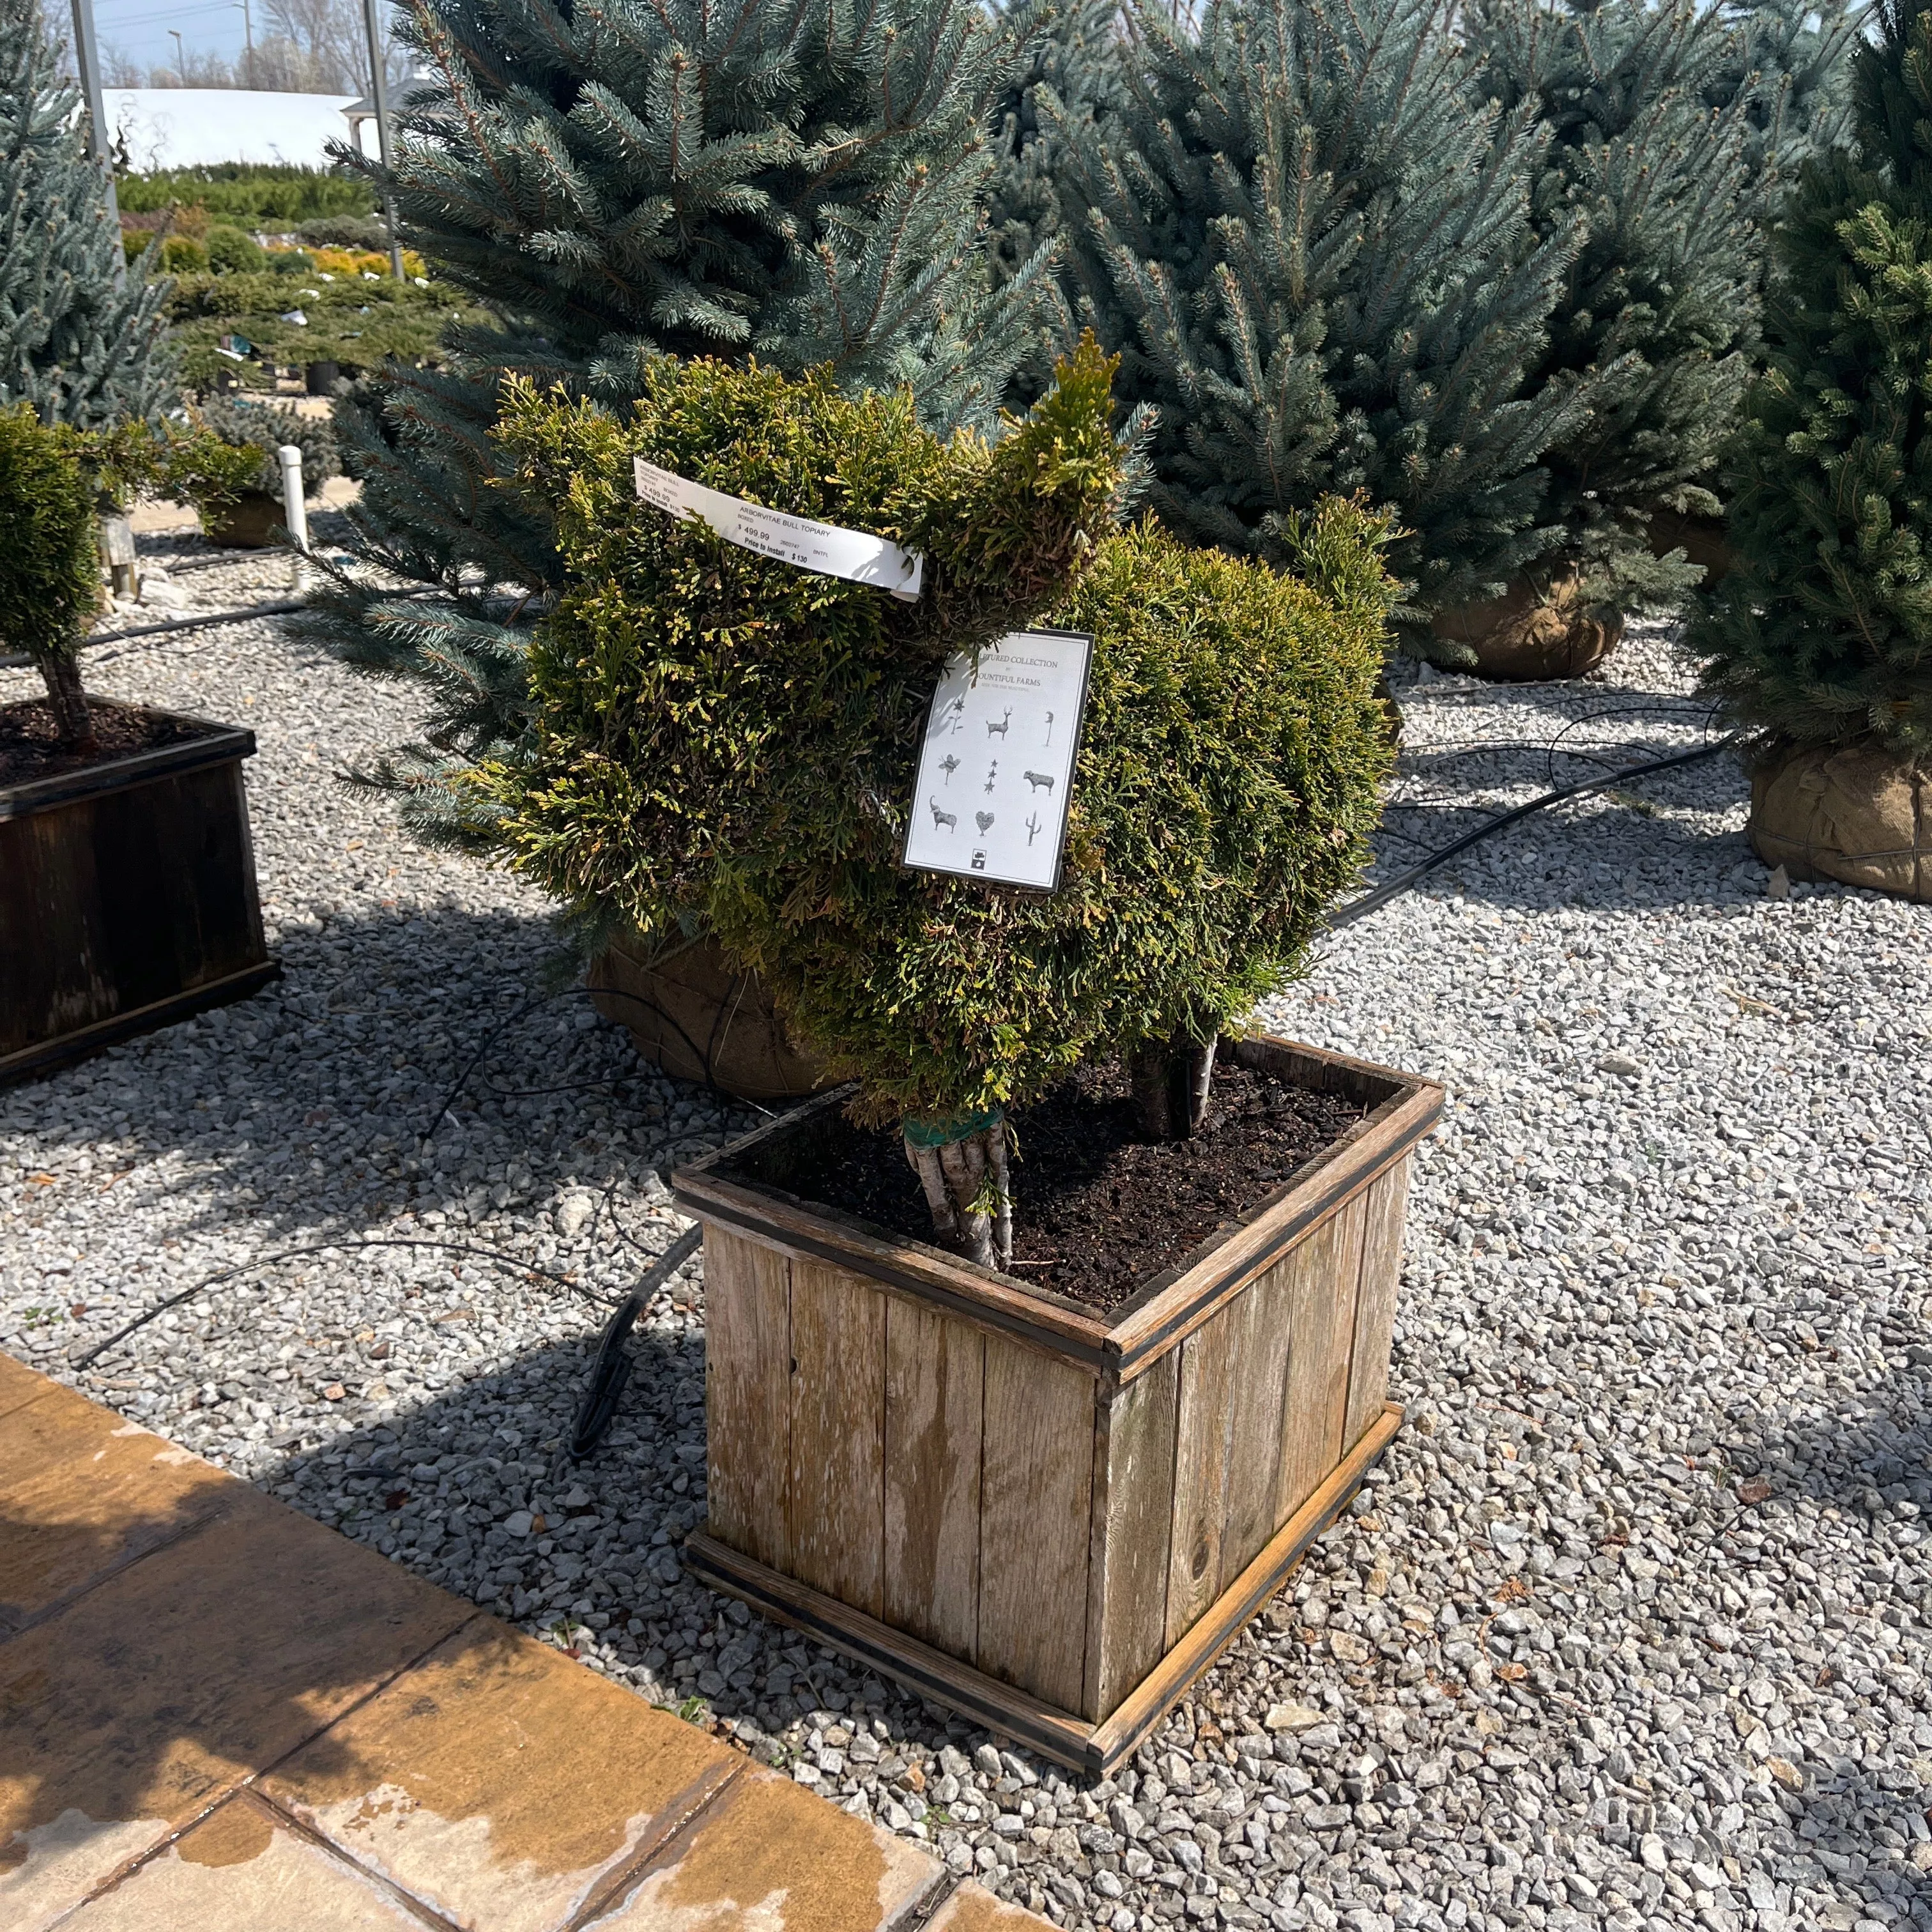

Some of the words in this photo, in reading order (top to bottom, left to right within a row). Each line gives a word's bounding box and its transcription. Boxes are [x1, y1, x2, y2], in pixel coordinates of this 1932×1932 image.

[649, 488, 670, 502] 499.99
[737, 514, 754, 523] BOXED
[740, 507, 781, 524] ARBORVITAE
[782, 520, 799, 530] BULL
[801, 525, 831, 537] TOPIARY
[744, 527, 769, 540] 499.99
[744, 537, 759, 548] Price
[767, 546, 785, 557] Install
[979, 653, 1009, 663] LPTURED
[1011, 656, 1058, 668] COLLECTION
[978, 673, 1015, 684] OUNTIFUL
[1016, 677, 1041, 687] FARMS
